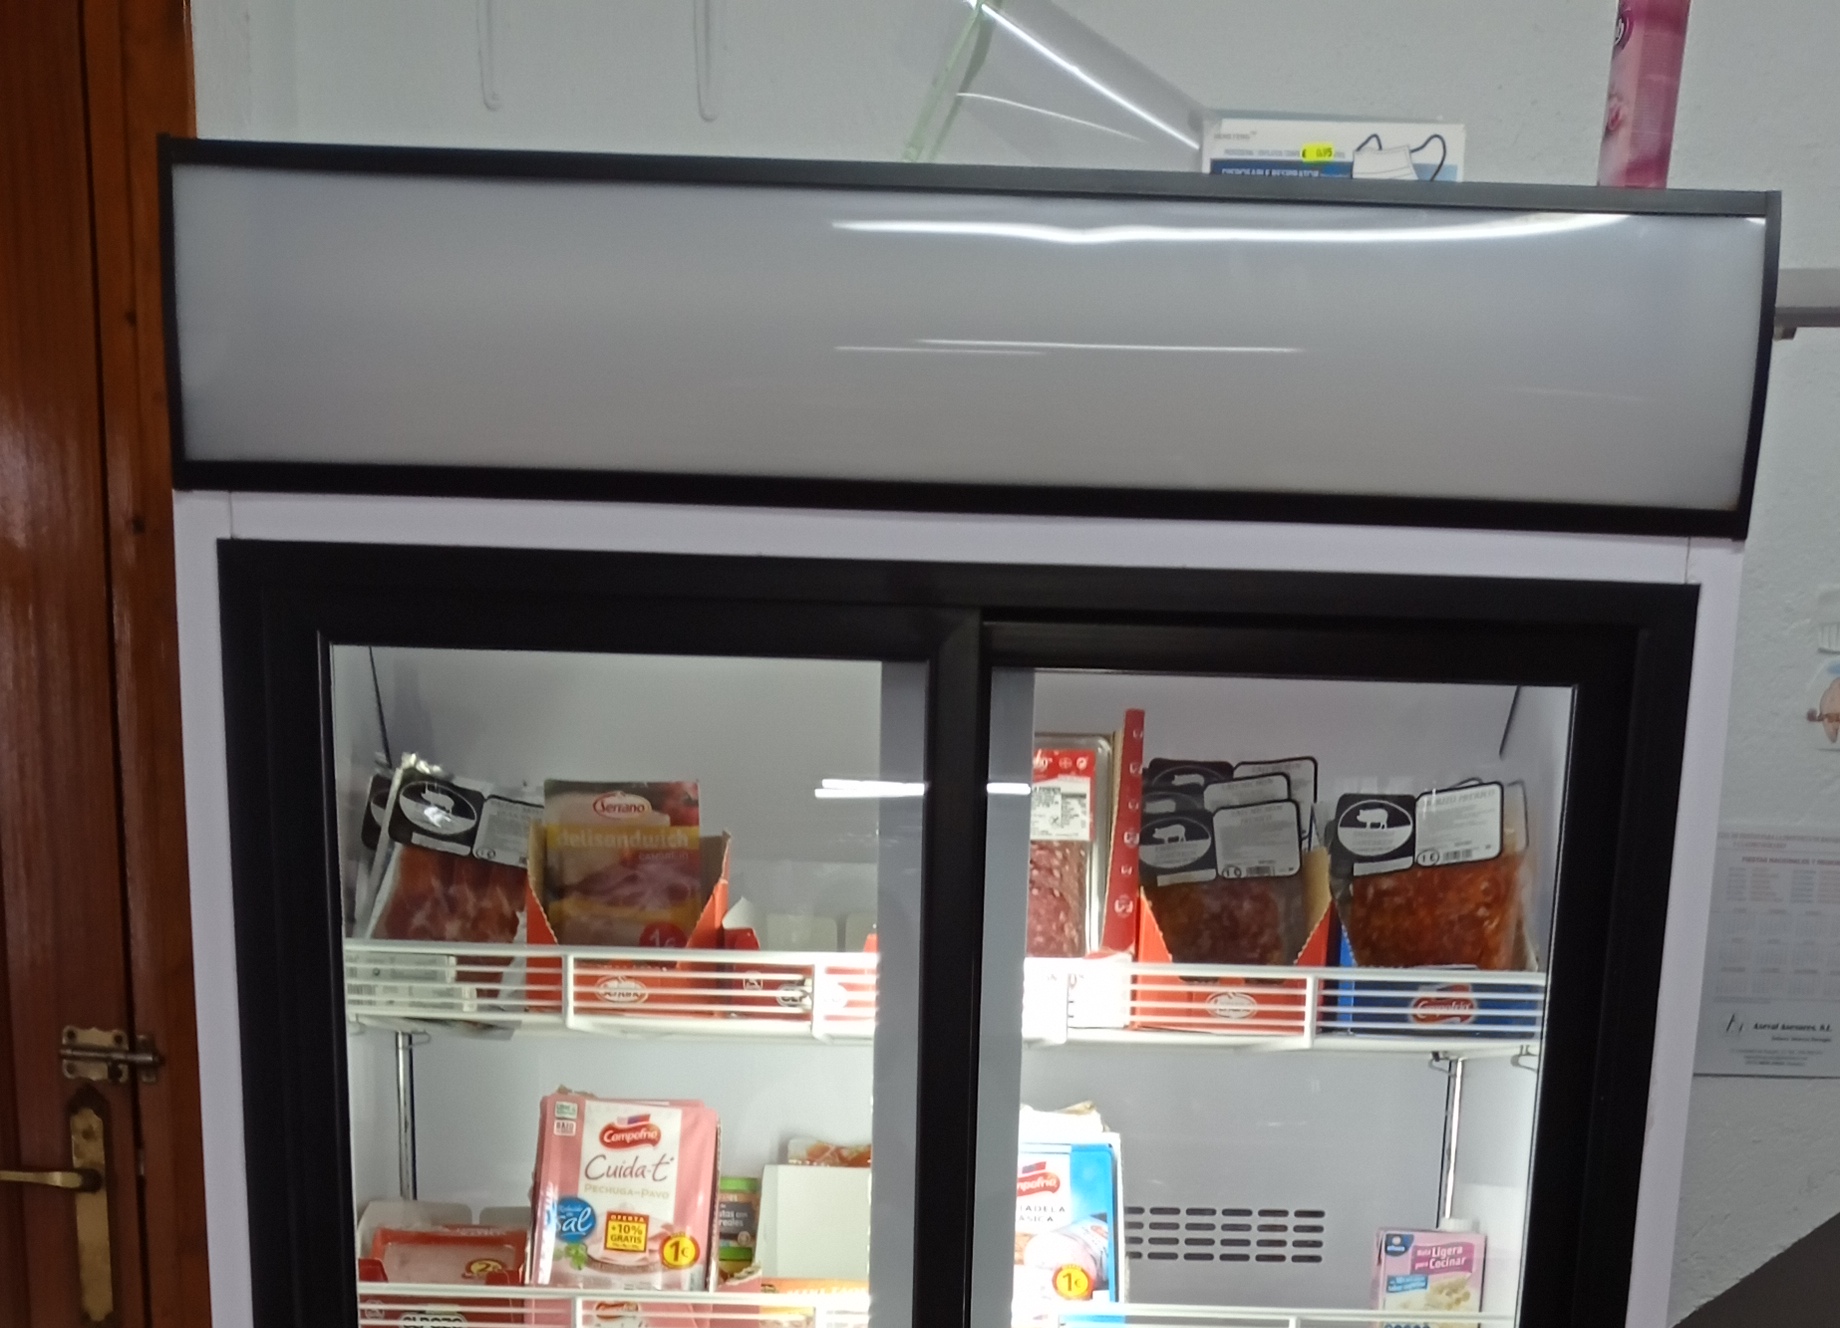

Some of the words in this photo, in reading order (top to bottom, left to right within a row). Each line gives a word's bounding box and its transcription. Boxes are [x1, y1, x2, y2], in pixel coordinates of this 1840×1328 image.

[610, 1233, 642, 1244] GRATIS
[1432, 1246, 1463, 1258] Ligera
[1429, 1257, 1466, 1269] Cocinar
